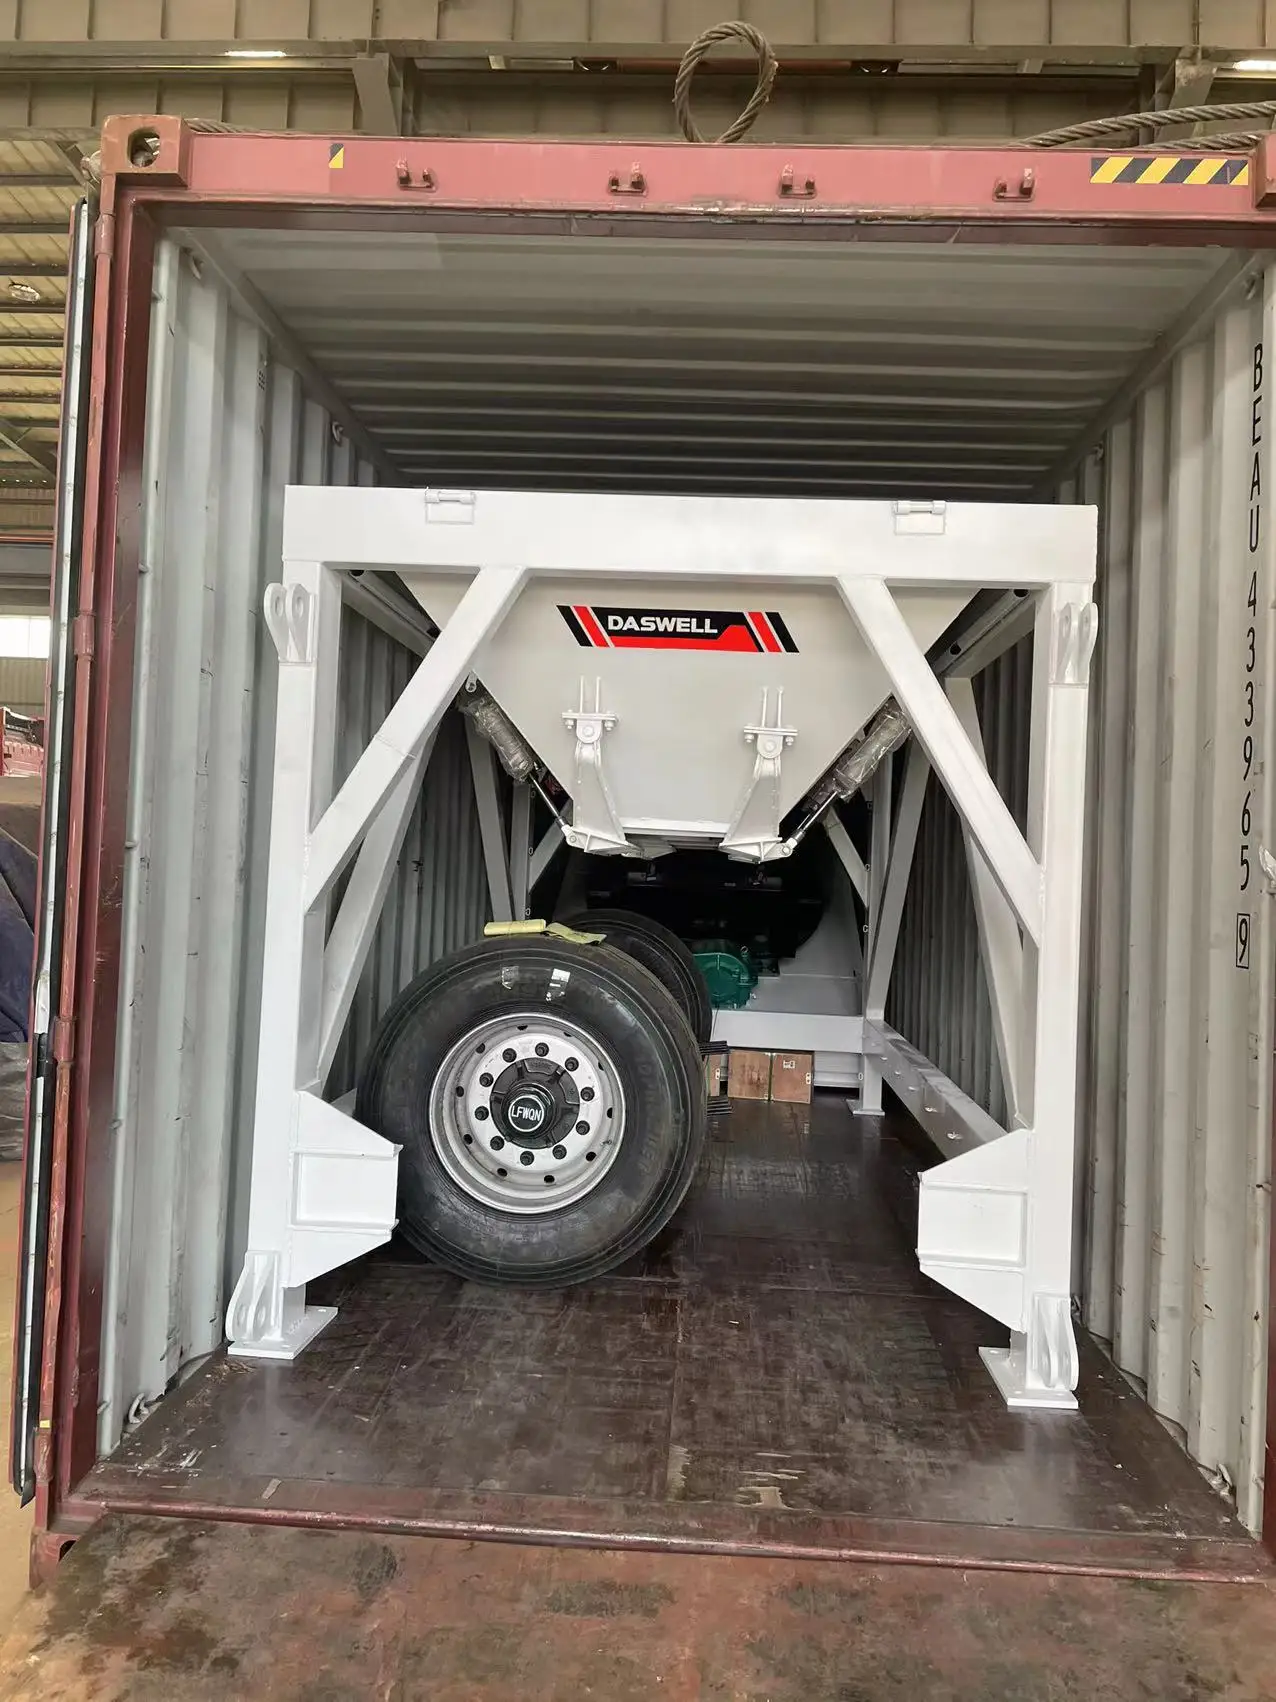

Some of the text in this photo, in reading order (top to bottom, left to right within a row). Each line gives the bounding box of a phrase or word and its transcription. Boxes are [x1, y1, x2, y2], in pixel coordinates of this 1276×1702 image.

[607, 614, 718, 634] DASWELL
[1237, 343, 1263, 965] BEAU 433965 9
